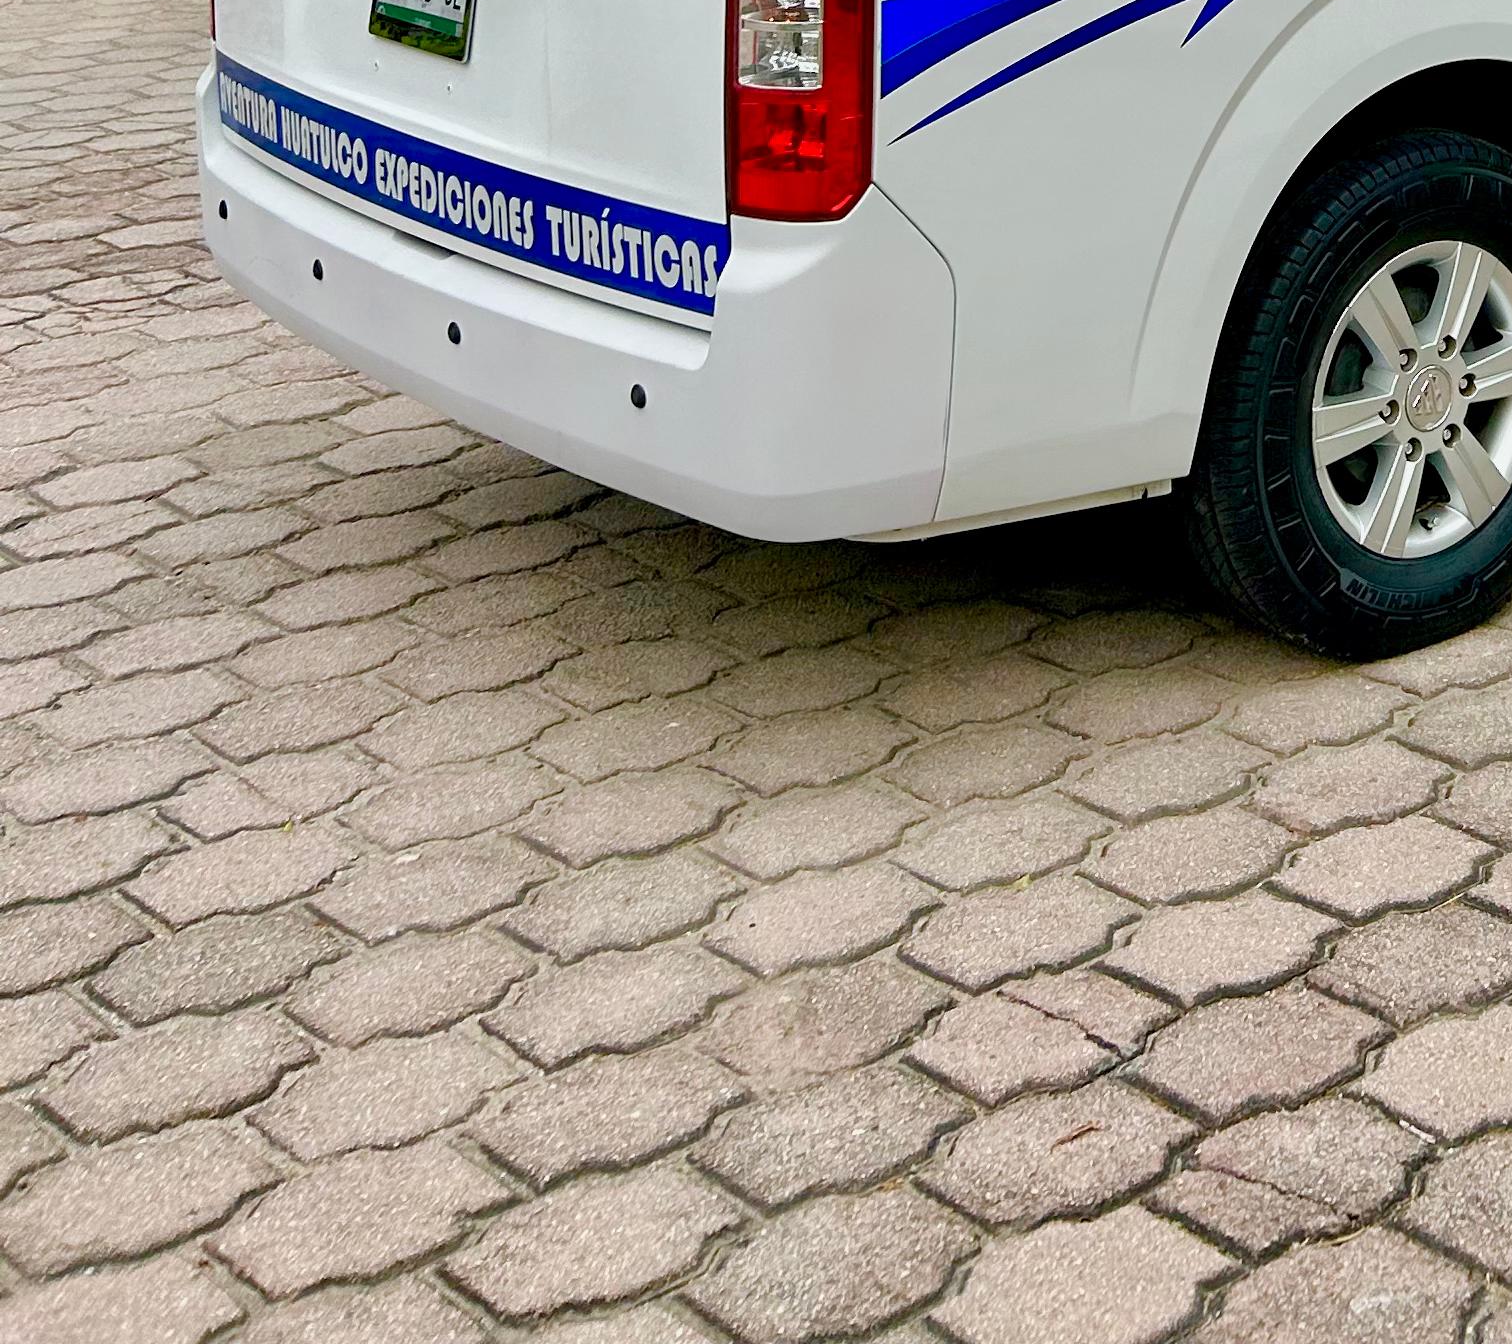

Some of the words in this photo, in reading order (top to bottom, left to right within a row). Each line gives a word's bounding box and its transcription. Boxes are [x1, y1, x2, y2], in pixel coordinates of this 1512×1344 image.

[219, 71, 278, 144] AVENTURA
[280, 105, 368, 185] HUATULCO
[375, 147, 534, 250] EXPEDICIONES
[546, 207, 718, 298] TURÍSTICAS
